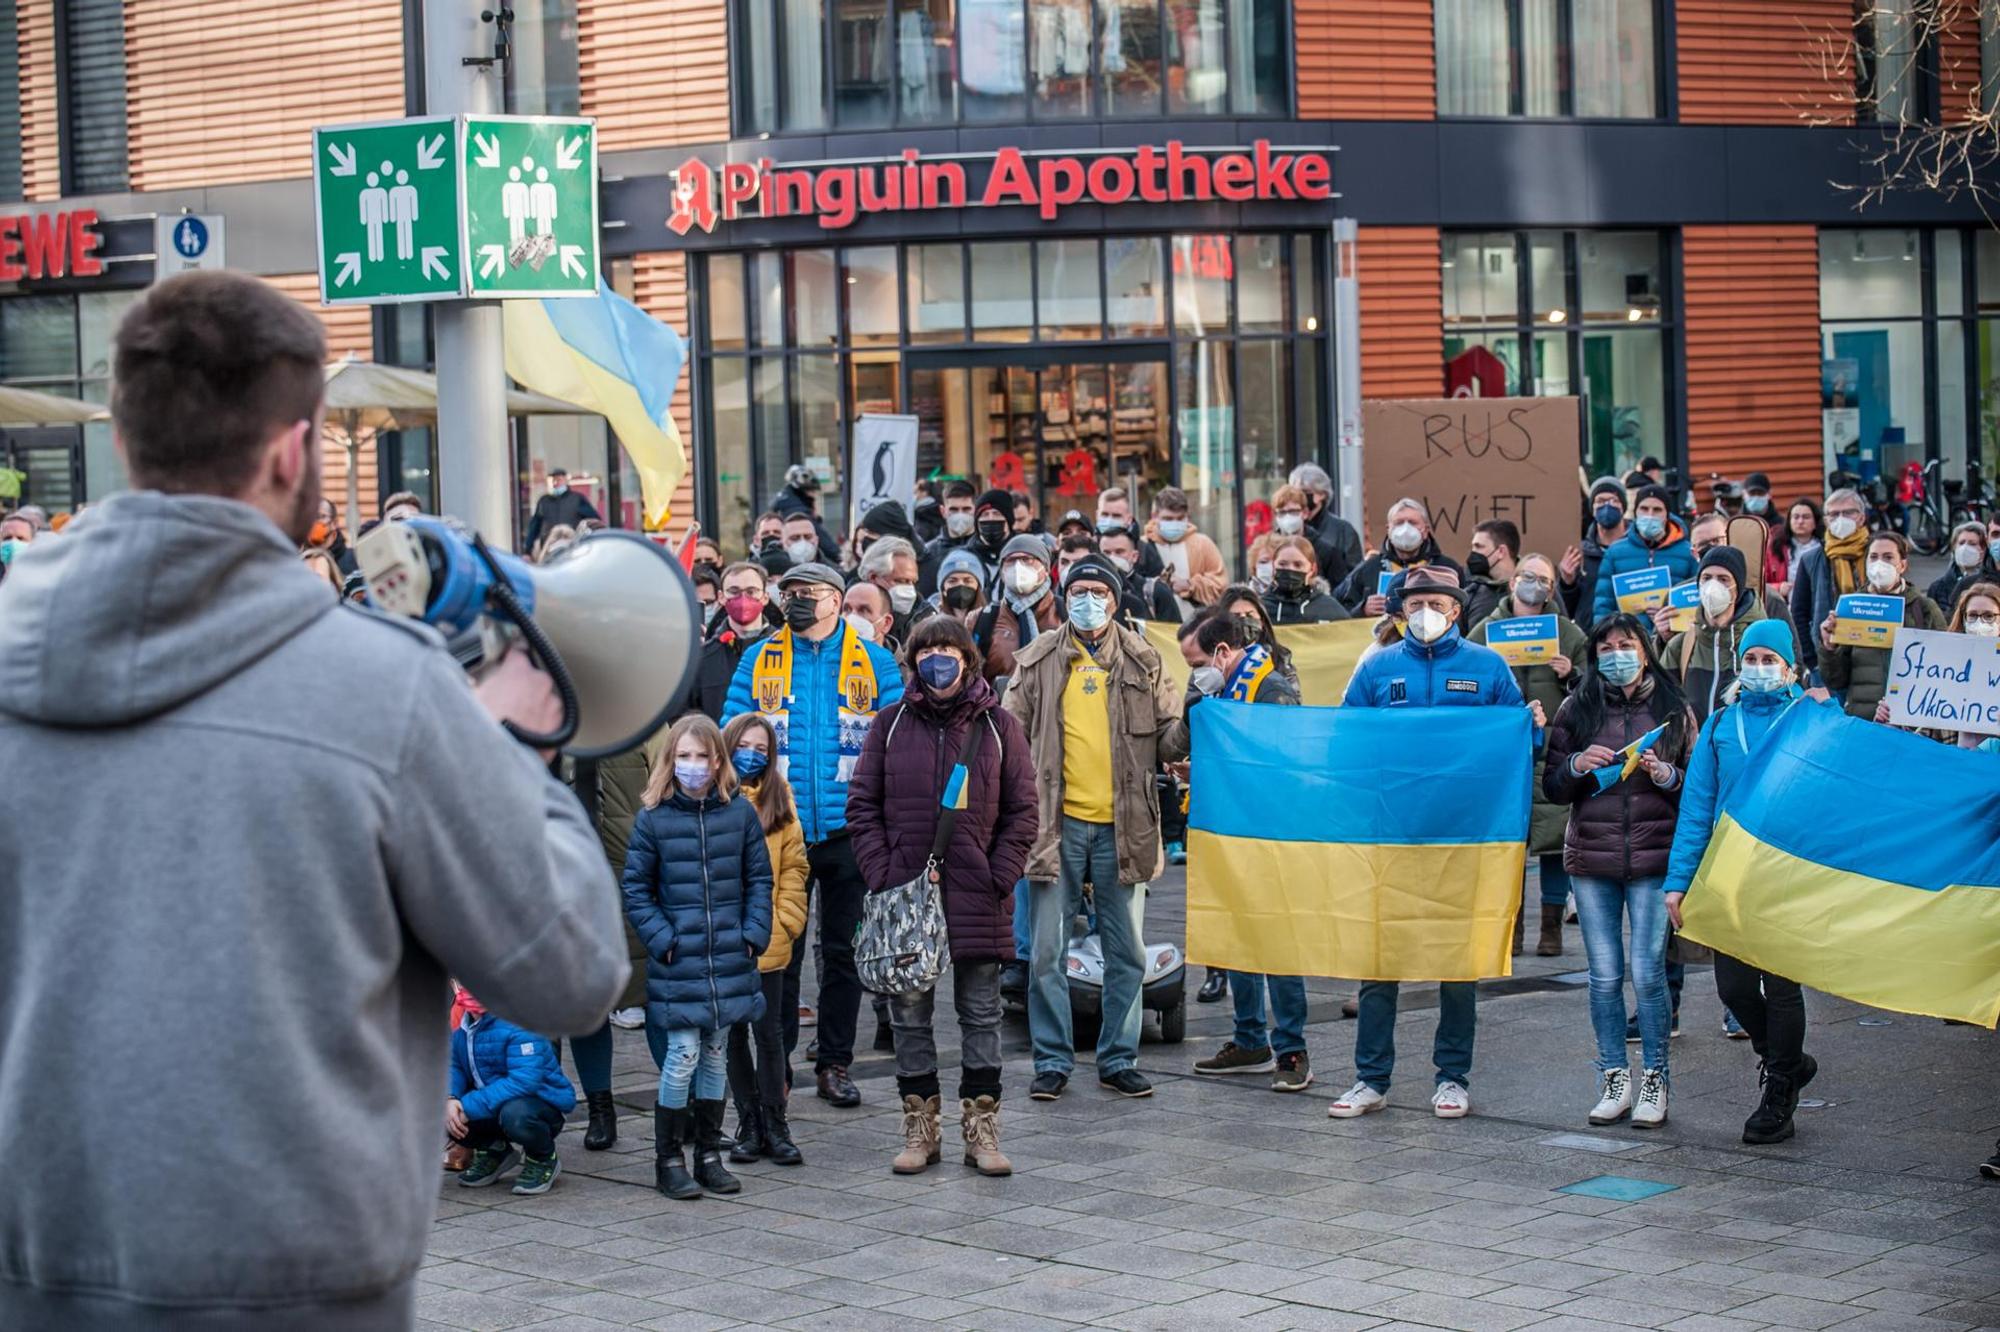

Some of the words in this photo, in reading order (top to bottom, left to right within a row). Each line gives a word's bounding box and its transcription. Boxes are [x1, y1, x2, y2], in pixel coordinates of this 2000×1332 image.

[722, 149, 967, 229] Pinguin
[983, 139, 1331, 219] Apotheke
[1423, 408, 1532, 461] RUS
[1896, 641, 1972, 683] Stand
[1907, 684, 1999, 723] Ukraine
